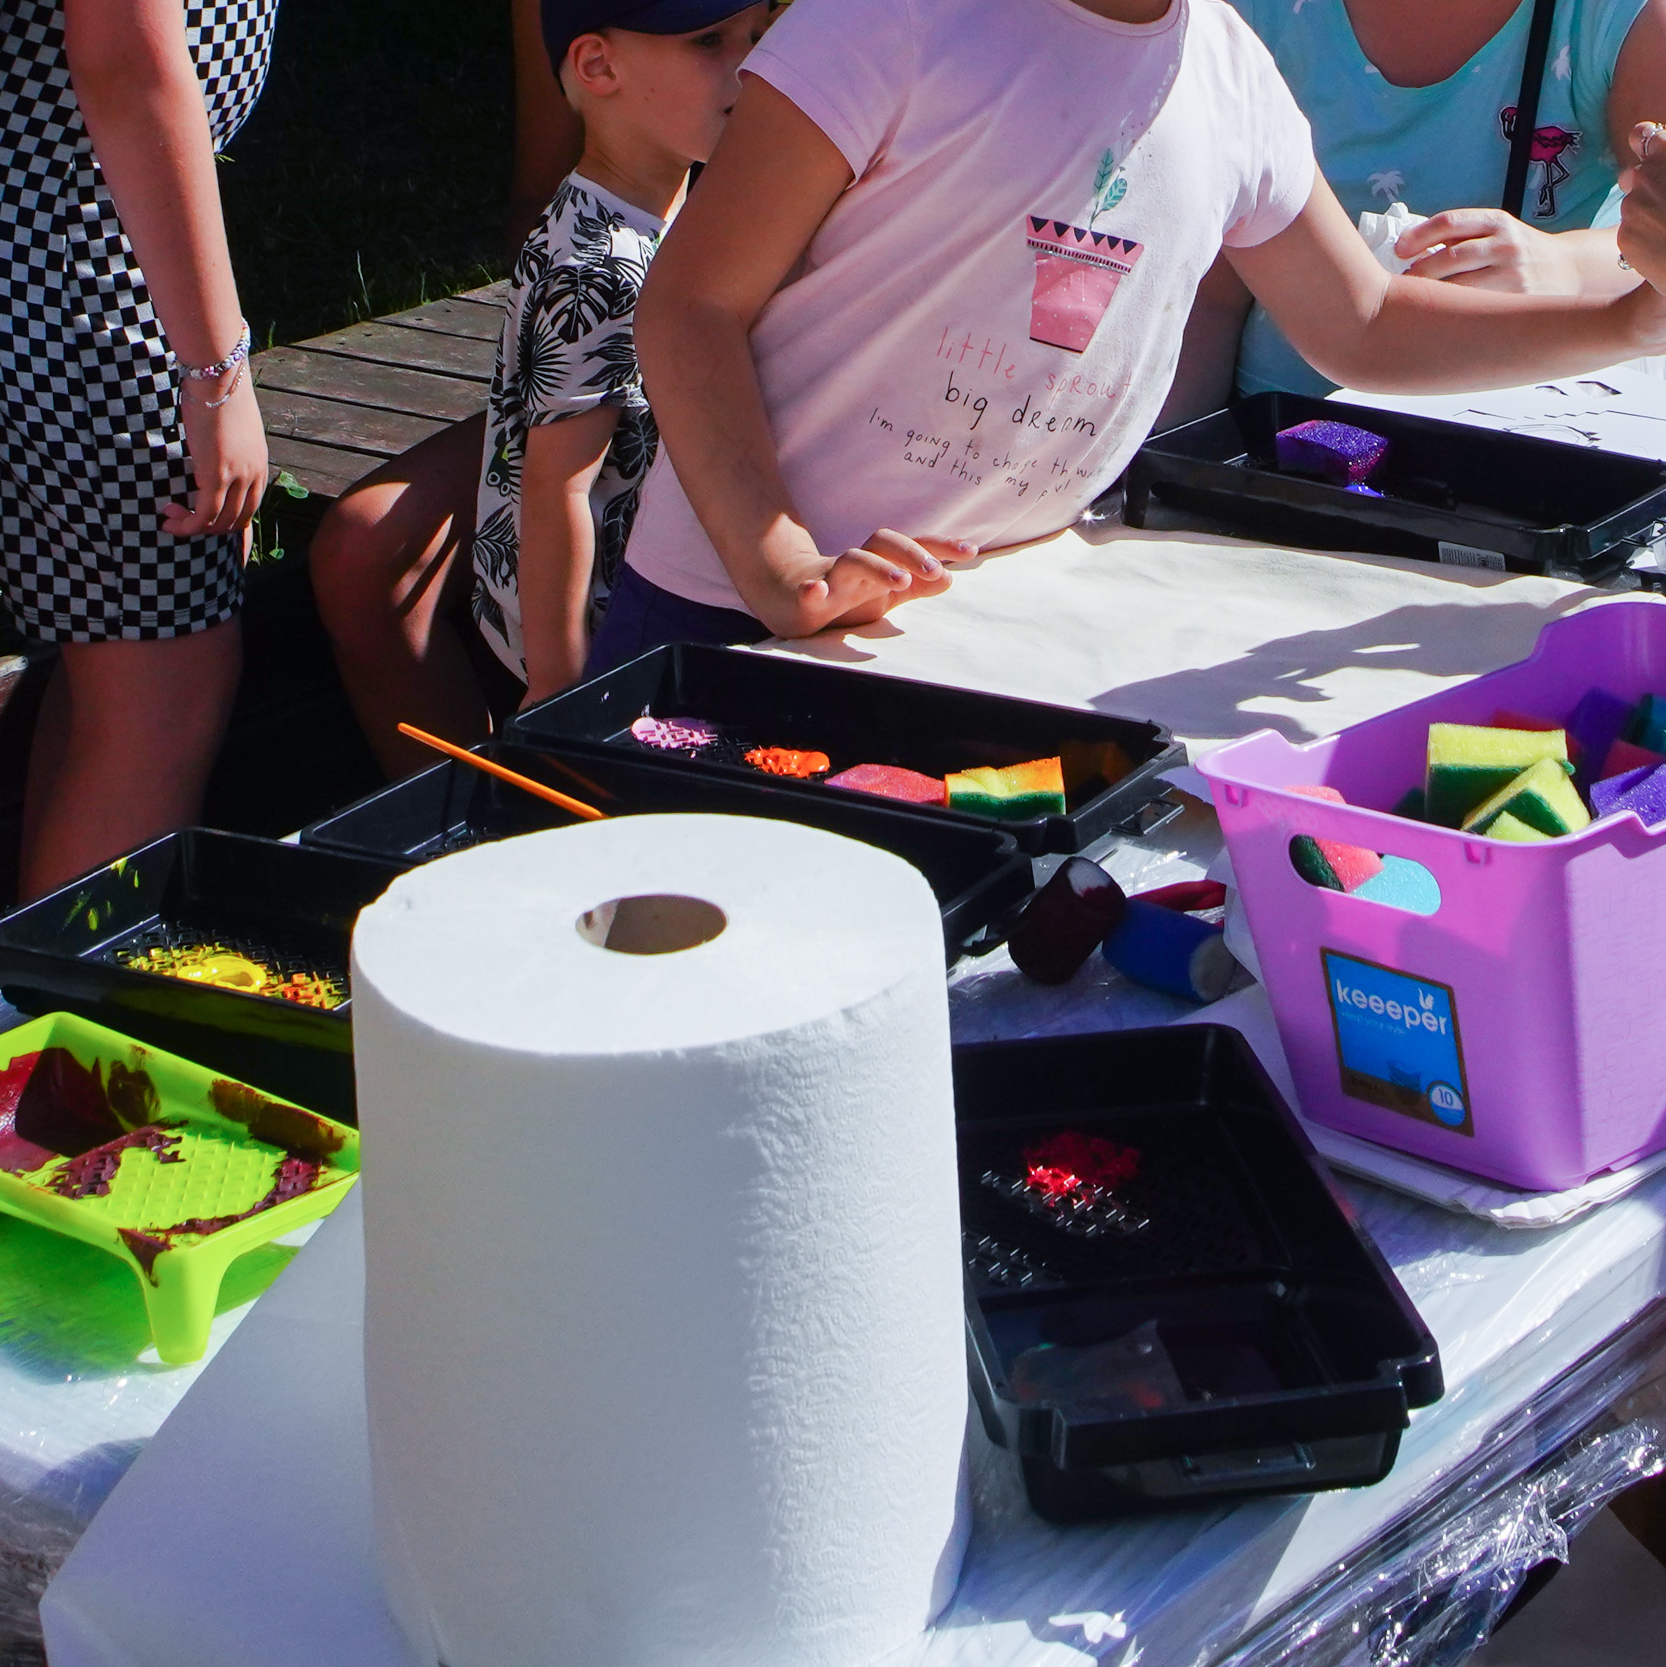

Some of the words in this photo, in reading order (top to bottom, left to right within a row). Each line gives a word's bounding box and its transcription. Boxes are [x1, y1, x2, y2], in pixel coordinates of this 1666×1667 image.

[936, 327, 1016, 379] little
[945, 371, 989, 431] big
[869, 407, 894, 432] I'm
[965, 439, 980, 460] to
[949, 459, 982, 486] this
[1005, 476, 1030, 497] my
[1336, 979, 1448, 1035] keeeper
[1438, 1088, 1454, 1107] 10
